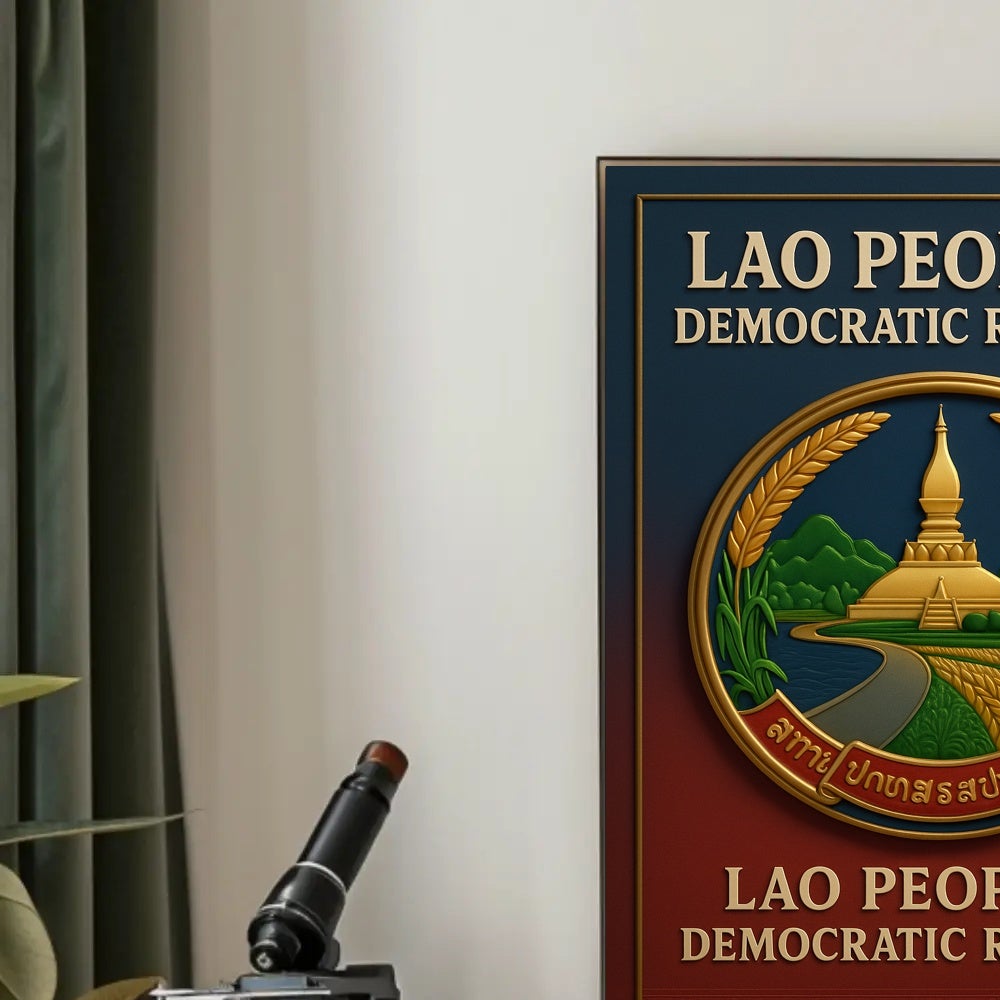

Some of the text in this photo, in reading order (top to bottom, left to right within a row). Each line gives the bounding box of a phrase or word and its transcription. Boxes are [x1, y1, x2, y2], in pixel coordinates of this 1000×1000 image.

[687, 230, 832, 290] LAO
[674, 307, 969, 345] DEMOCRATIC
[724, 865, 841, 911] LAO
[680, 927, 967, 962] DEMOCRATIC
